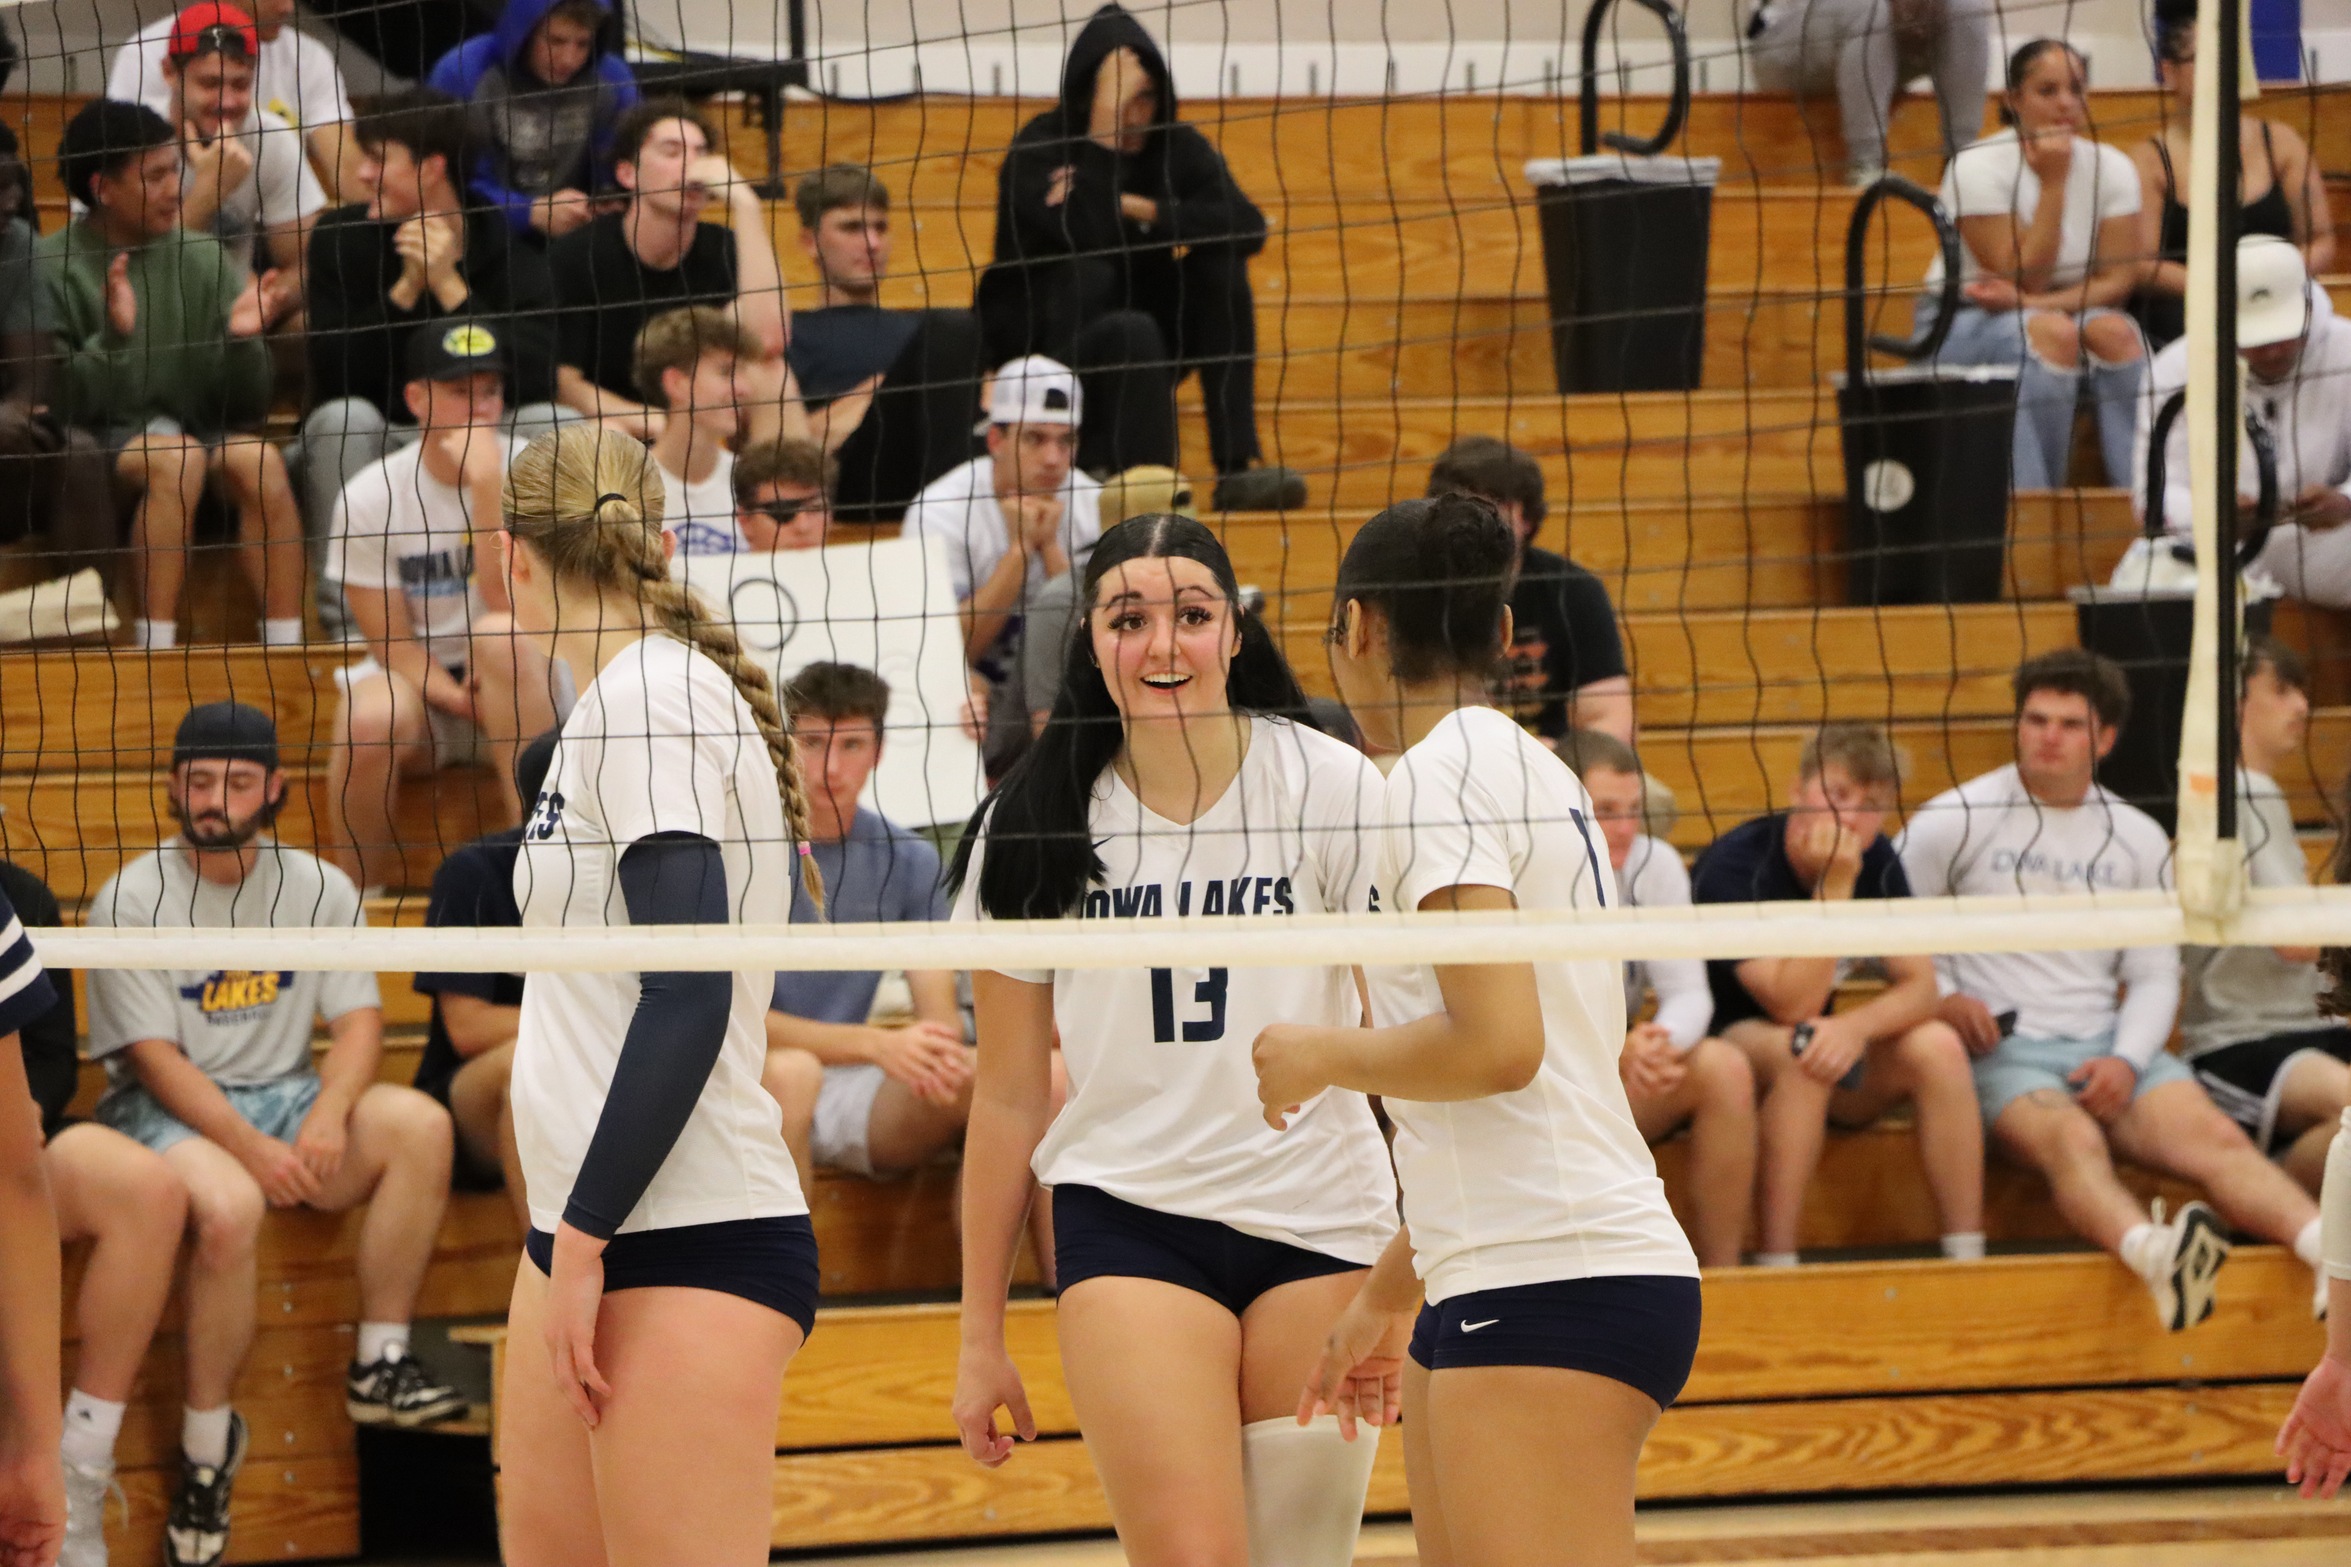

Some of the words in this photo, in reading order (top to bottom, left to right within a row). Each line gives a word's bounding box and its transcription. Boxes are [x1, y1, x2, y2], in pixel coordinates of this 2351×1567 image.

[1081, 884, 1162, 918] OWA
[1178, 876, 1294, 917] LAKES
[201, 970, 280, 1012] LAKES
[1151, 967, 1228, 1043] 13
